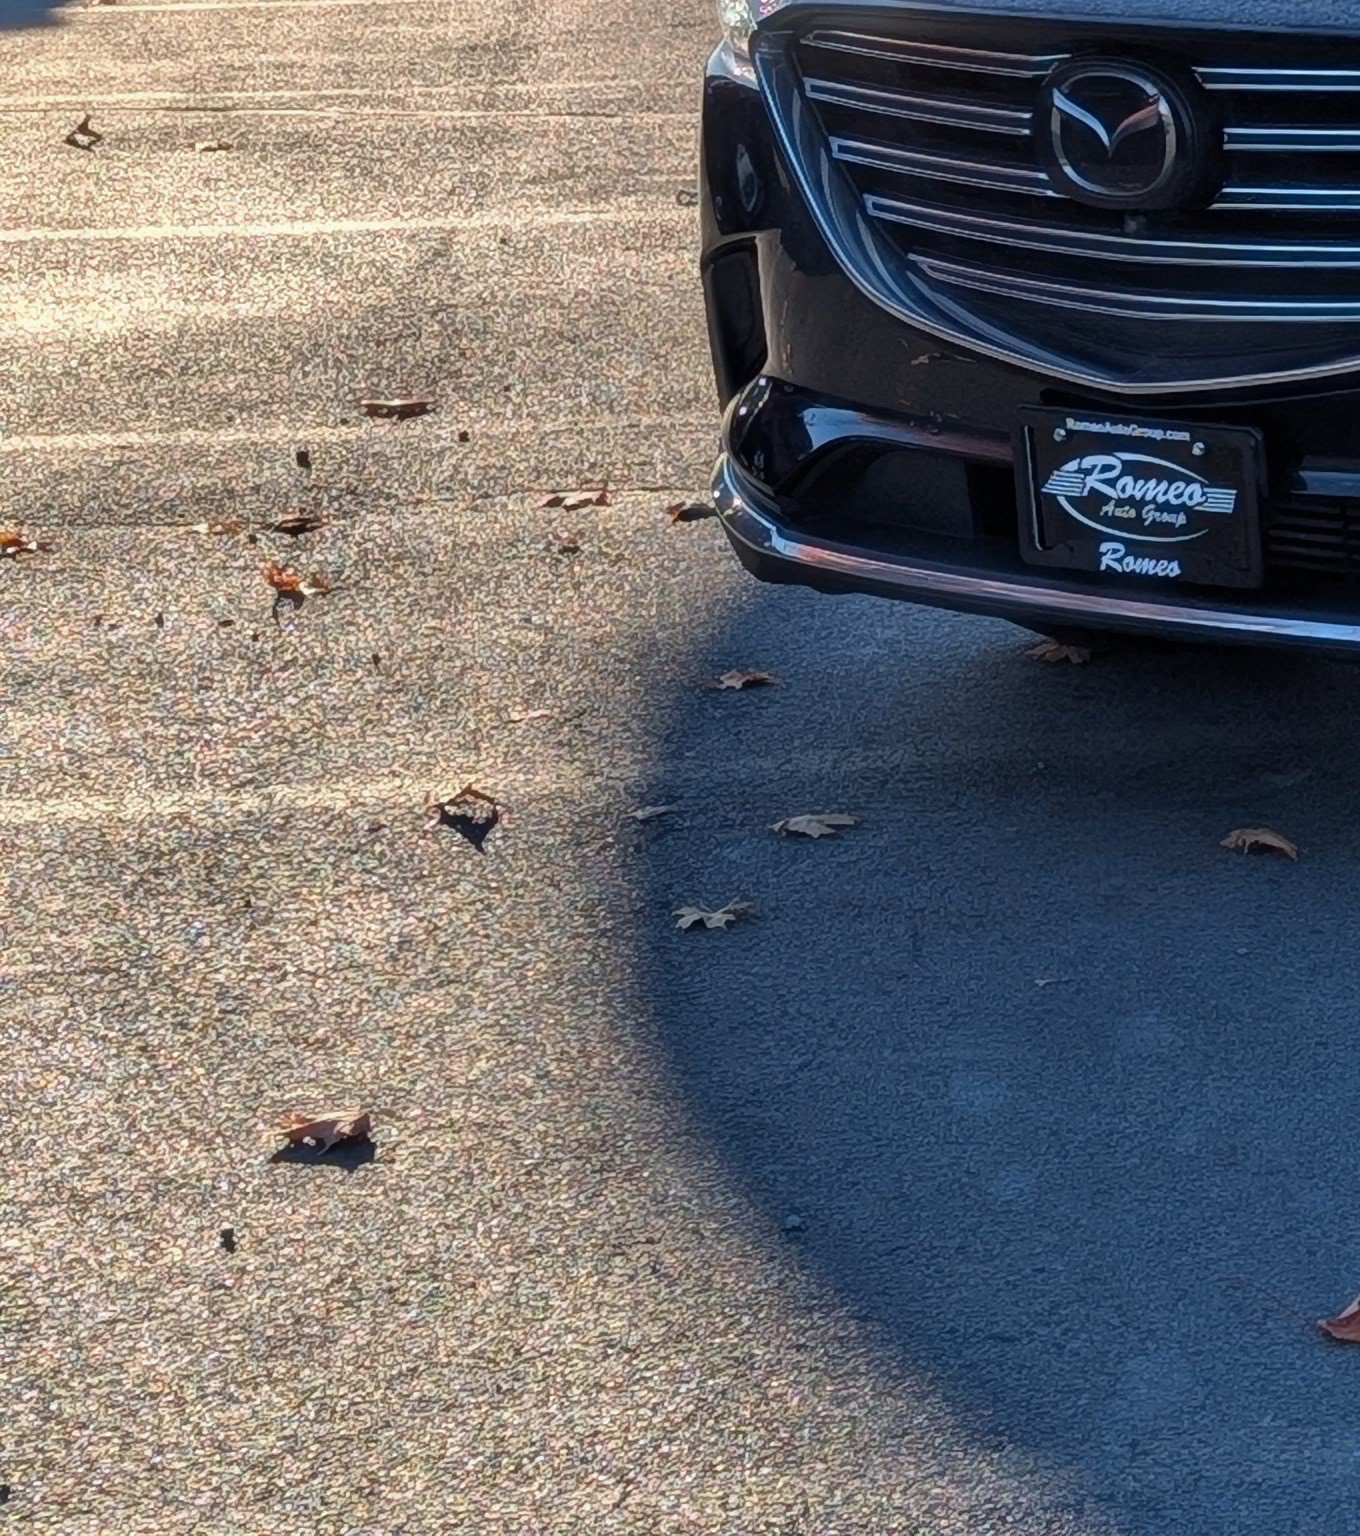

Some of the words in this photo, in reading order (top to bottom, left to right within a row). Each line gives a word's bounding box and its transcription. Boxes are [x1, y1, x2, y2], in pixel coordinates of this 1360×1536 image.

[1080, 454, 1206, 505] Romeo
[1099, 499, 1137, 519] Auto
[1141, 503, 1188, 529] Group
[1098, 541, 1182, 578] Romeo
